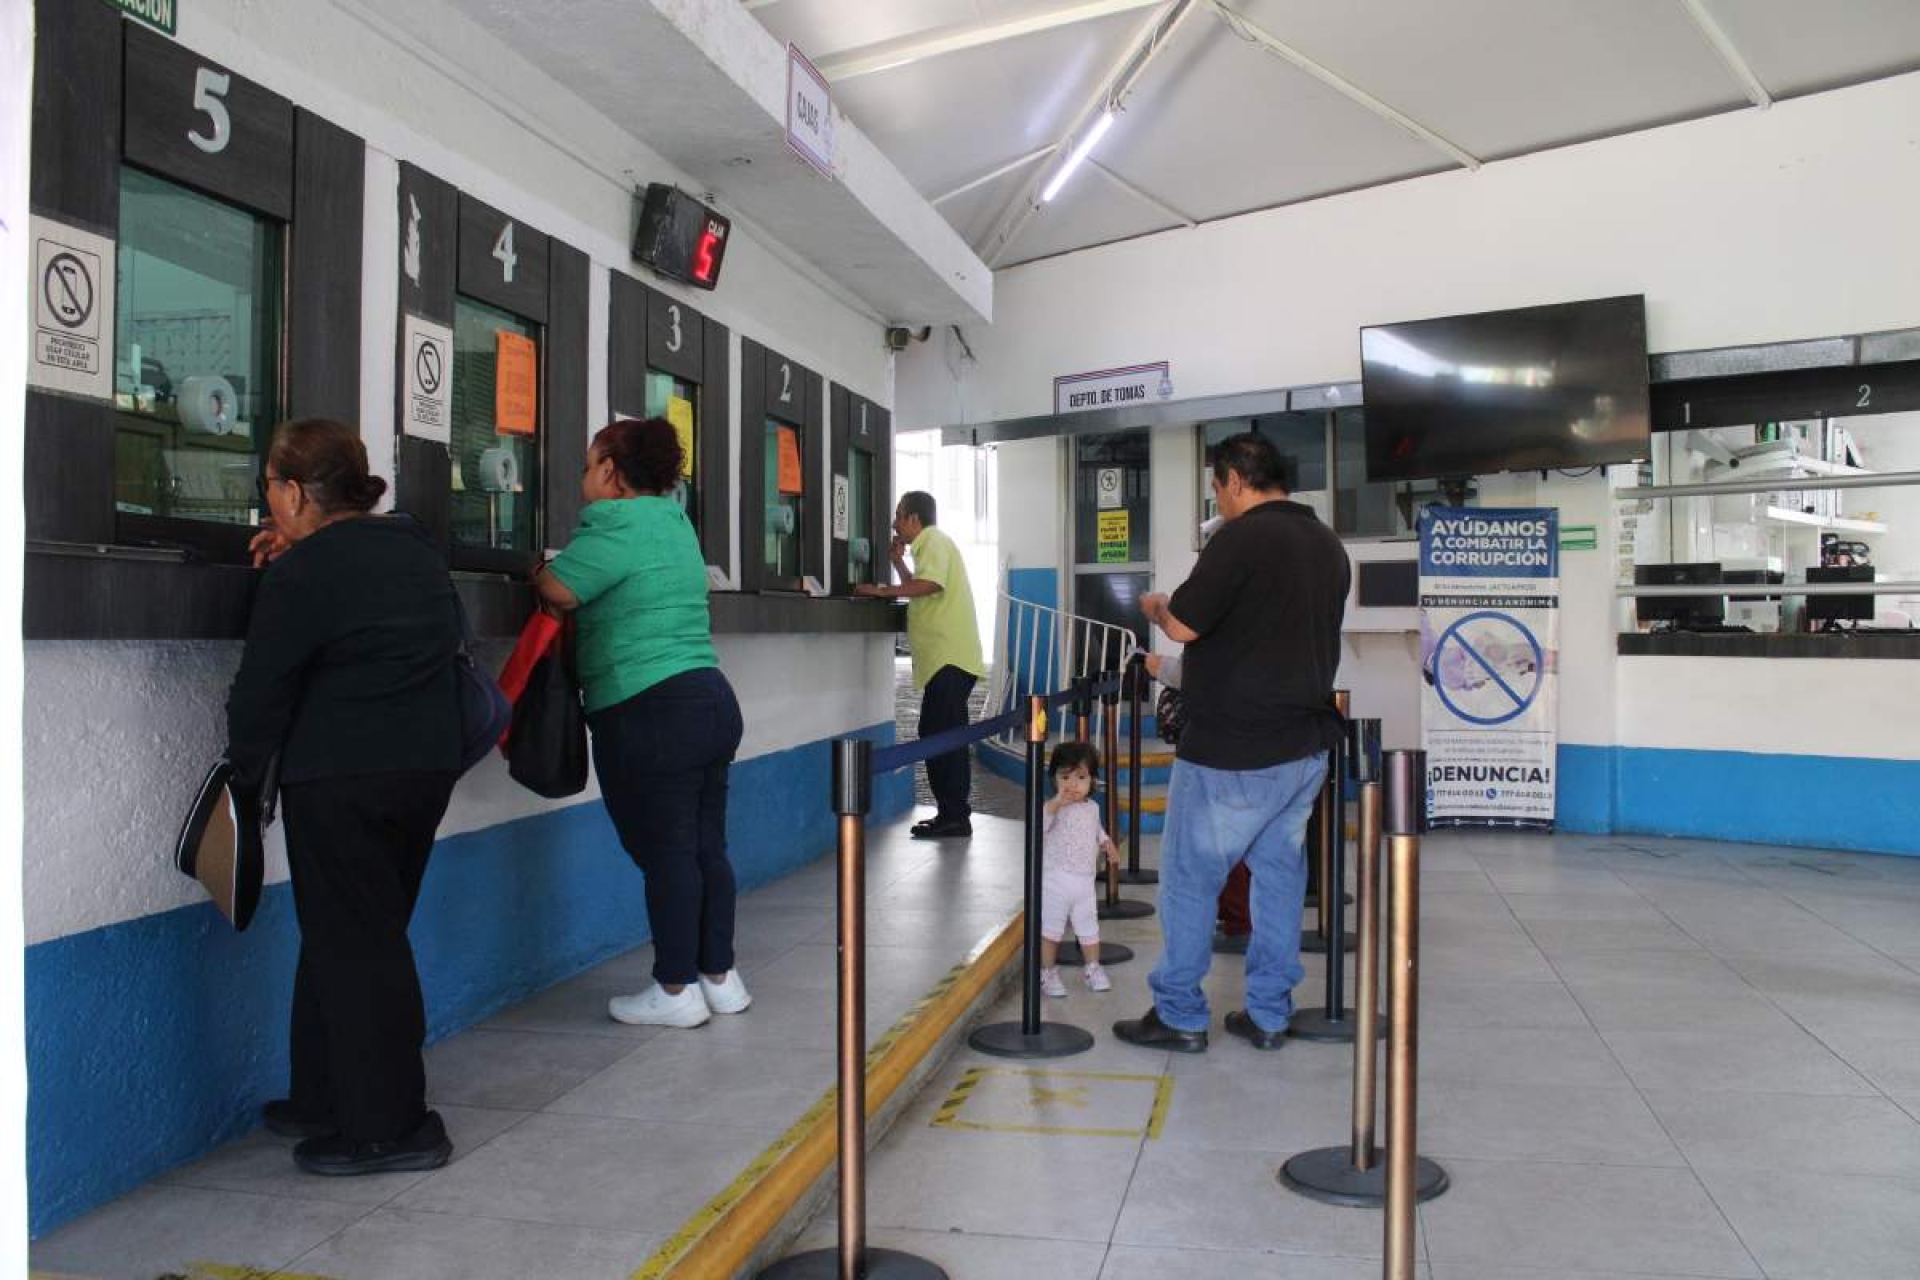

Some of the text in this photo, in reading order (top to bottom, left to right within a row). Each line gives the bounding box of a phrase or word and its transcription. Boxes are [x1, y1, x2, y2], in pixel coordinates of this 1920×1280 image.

[188, 66, 231, 153] 5
[797, 90, 819, 136] CAJAS
[492, 221, 517, 282] 4
[695, 233, 717, 280] 5
[666, 305, 682, 352] 3
[780, 364, 791, 402] 2
[1069, 384, 1145, 407] DEPTO. DE TOMAS
[1856, 383, 1871, 407] 2
[861, 402, 868, 435] 1
[1684, 402, 1691, 424] 1
[1431, 516, 1548, 537] AYÚDANOS
[1431, 537, 1547, 550] A COMBATIR LA
[1431, 550, 1548, 566] CORRUPCIÓN
[1428, 765, 1551, 786] ¡DENUNCIA!
